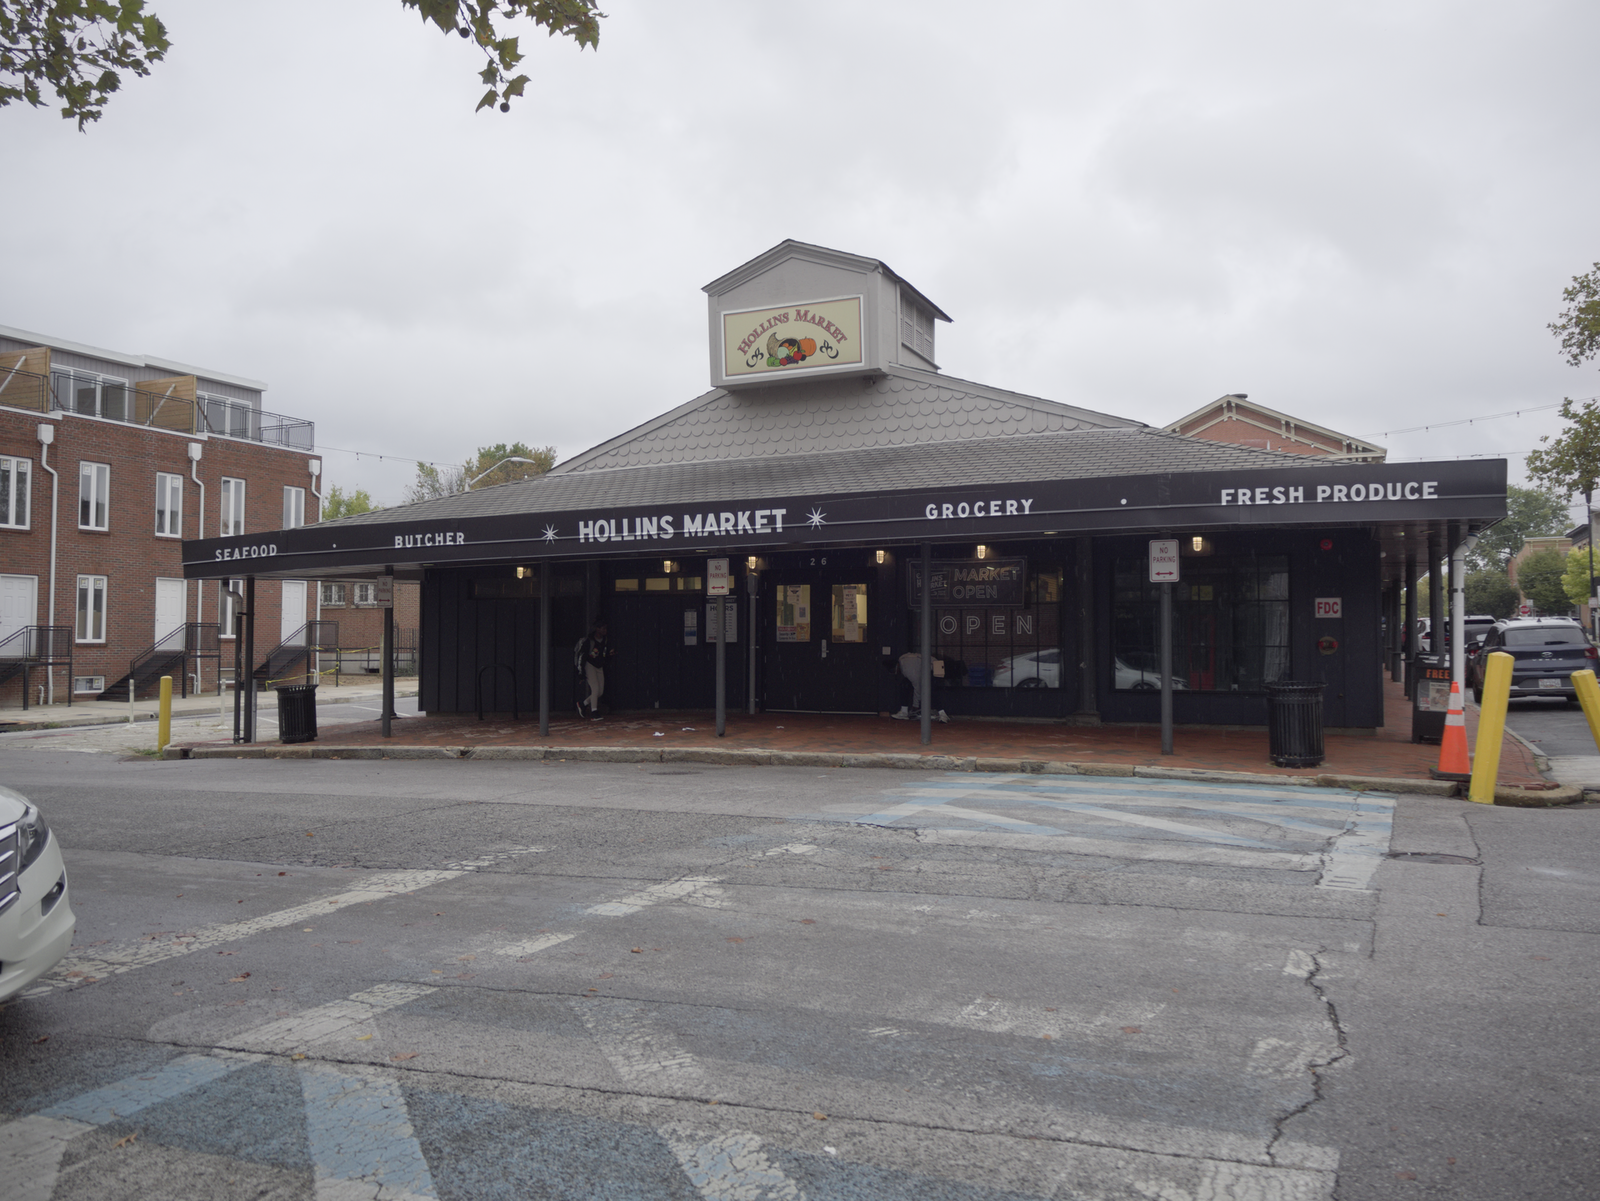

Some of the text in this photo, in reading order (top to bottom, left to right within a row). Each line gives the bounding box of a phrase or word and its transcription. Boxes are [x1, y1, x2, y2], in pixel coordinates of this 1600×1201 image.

[737, 309, 848, 356] HOLLINS MARKET
[1221, 481, 1438, 505] FRESH PRODUCE
[925, 498, 1034, 519] GROCERY
[579, 508, 787, 543] HOLLINS MARKET
[394, 532, 465, 548] BUTCHER
[215, 544, 278, 561] SEAFOOD
[1159, 546, 1168, 554] NO
[954, 566, 1020, 581] MARKET
[952, 585, 998, 599] OPEN
[1317, 601, 1339, 614] FDC
[940, 615, 1033, 635] OPEN
[1426, 669, 1450, 679] FREE
